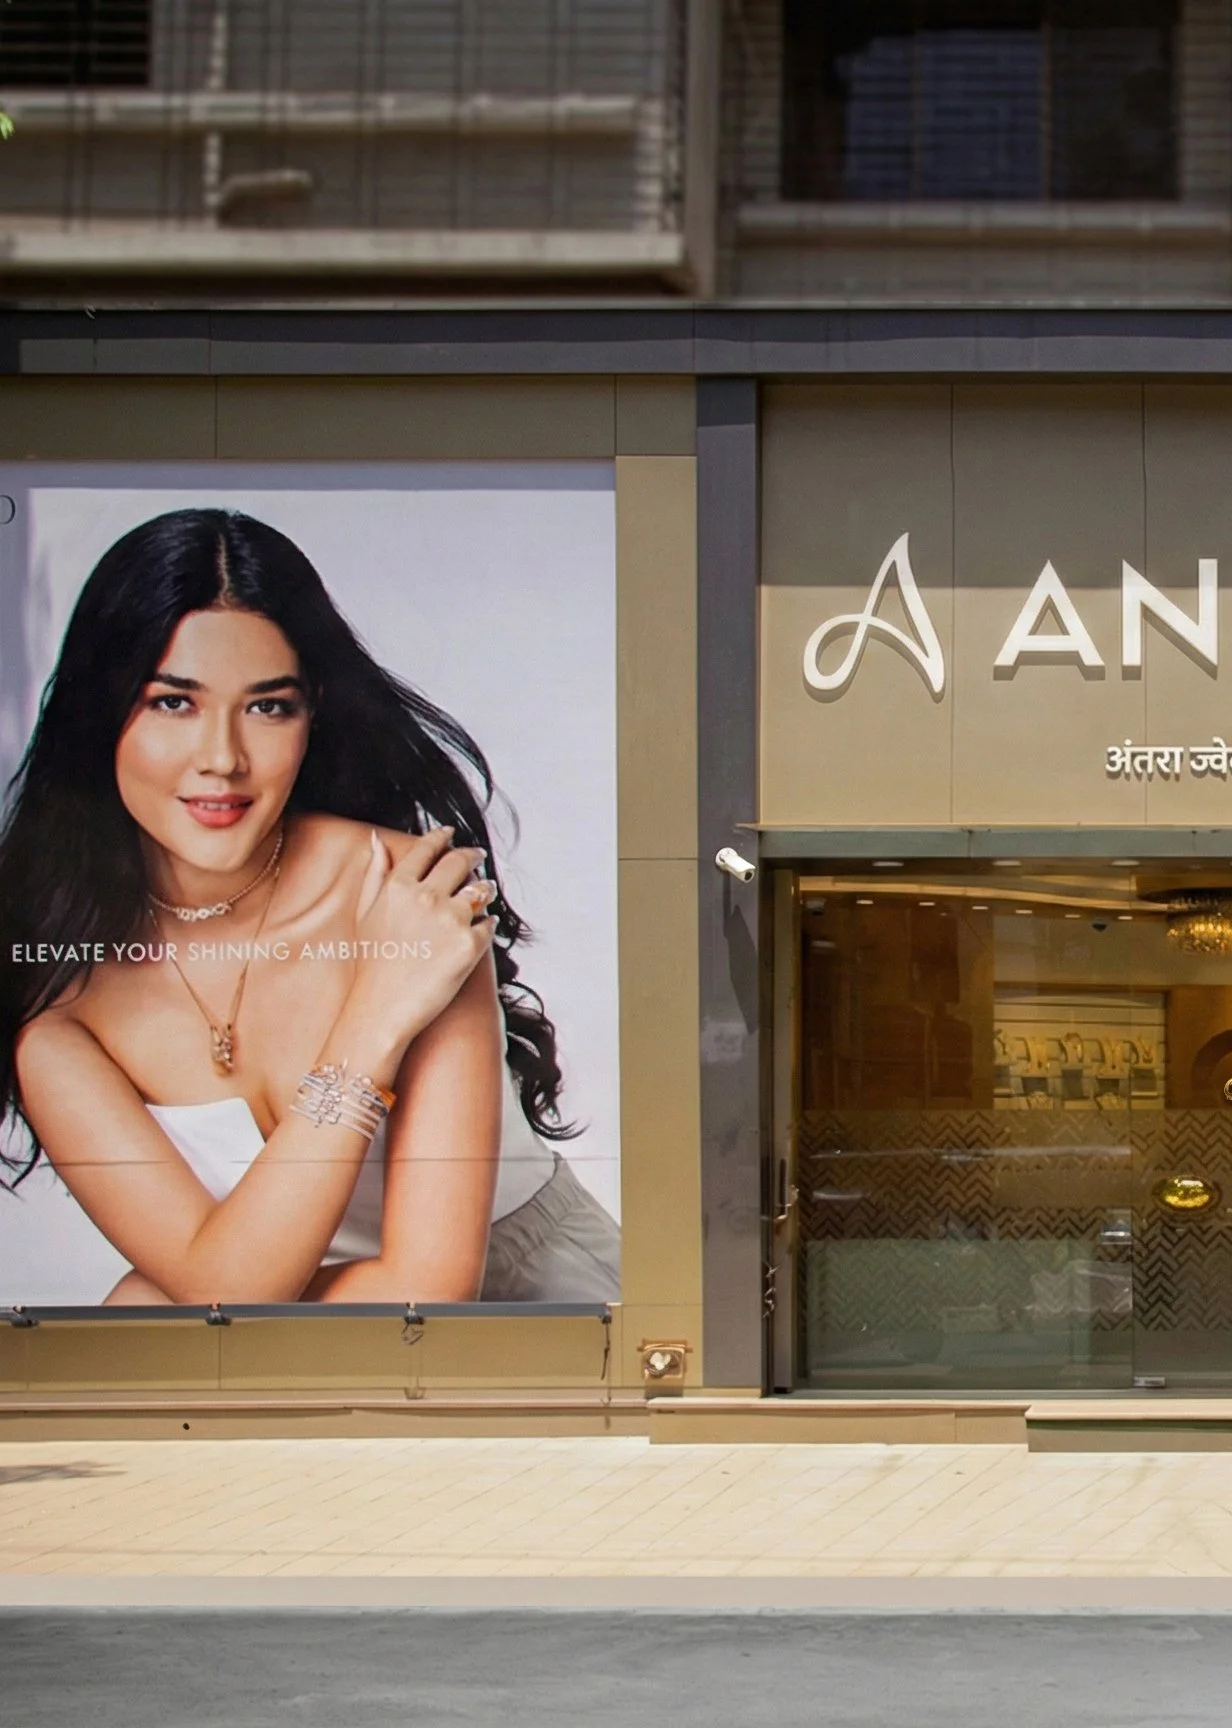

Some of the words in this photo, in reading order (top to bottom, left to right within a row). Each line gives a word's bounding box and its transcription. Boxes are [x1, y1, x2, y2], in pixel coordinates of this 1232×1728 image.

[1105, 738, 1184, 774] अंतरा
[11, 942, 105, 963] ELEVATE
[112, 942, 178, 962] YOUR
[188, 941, 291, 961] SHINING
[299, 940, 433, 960] AMBITIONS
